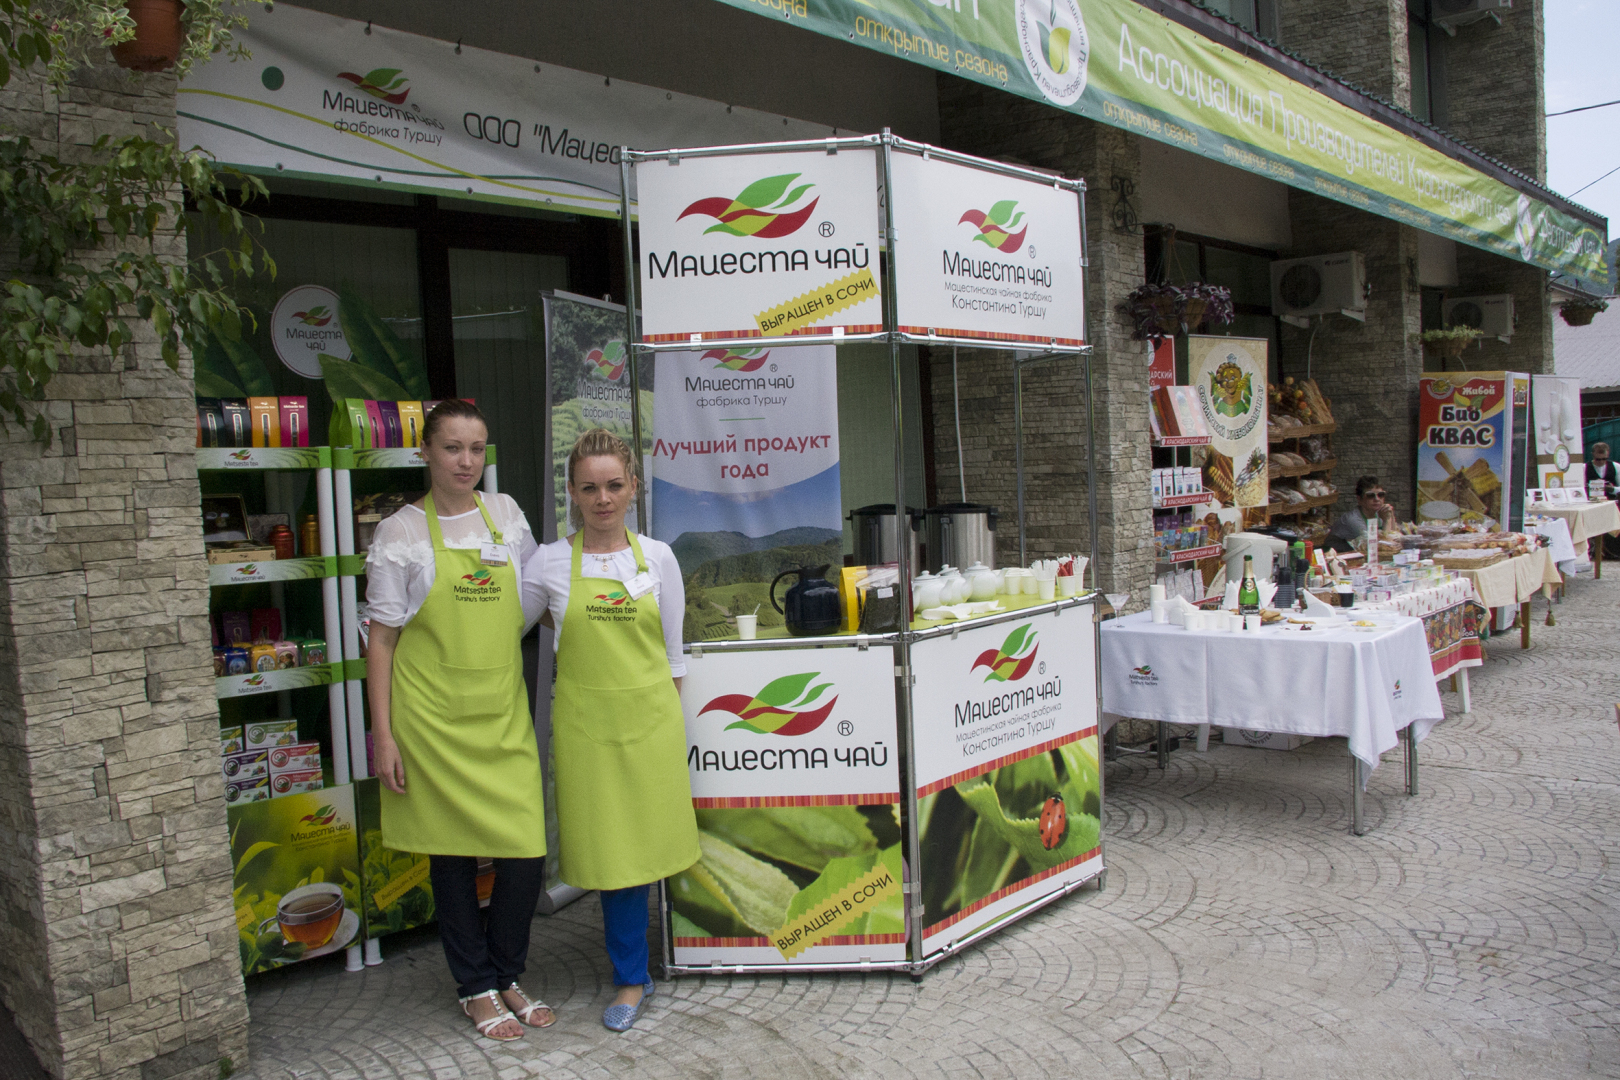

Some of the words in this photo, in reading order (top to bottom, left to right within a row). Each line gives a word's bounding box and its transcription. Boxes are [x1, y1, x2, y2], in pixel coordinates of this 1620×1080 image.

[855, 16, 949, 63] открытие
[955, 49, 1008, 81] сезона
[1119, 23, 1263, 128] Ассоциация
[1269, 90, 1404, 185] Производителей
[333, 118, 400, 137] фабрика
[403, 127, 442, 146] Туршу
[463, 112, 521, 148] ООО
[1103, 101, 1161, 134] открытие
[1164, 122, 1198, 146] сезона
[649, 250, 809, 279] Мацеста
[815, 243, 869, 269] чай
[943, 250, 1025, 284] Мацеста
[1027, 266, 1052, 288] чай
[761, 297, 823, 332] ВЫРАЩЕН
[825, 294, 835, 305] В
[836, 278, 875, 301] СОЧИ
[945, 282, 998, 296] Мацестинская
[1022, 290, 1053, 303] фабрика
[952, 295, 1017, 314] Константина
[1019, 301, 1047, 320] Туршу
[286, 327, 343, 340] Мацеста
[305, 341, 326, 351] чай
[685, 376, 766, 391] Мацеста
[768, 375, 795, 389] чай
[1462, 385, 1496, 395] Живой
[696, 395, 750, 408] фабрика
[753, 395, 787, 407] Туршу
[1441, 405, 1481, 422] Био
[652, 434, 737, 460] Лучший
[744, 435, 831, 456] продукт
[1166, 436, 1197, 445] КРАСНОДАРСКИЙ
[1429, 427, 1492, 445] КВАС
[720, 463, 769, 479] года
[1168, 495, 1200, 505] КРАСНОДАРСКИЙ
[1176, 549, 1208, 559] КРАСНОДАРСКИЙ
[453, 585, 488, 594] Matsesta
[489, 586, 502, 594] tea
[586, 605, 623, 613] Matsesta
[624, 606, 637, 614] tea
[954, 687, 1034, 728] Мацеста
[1036, 675, 1061, 700] чай
[955, 716, 1006, 743] Мацестинская
[1007, 711, 1030, 726] чайная
[1031, 702, 1062, 720] фабрика
[962, 726, 1024, 757] Константина
[1027, 717, 1056, 737] Туршу
[834, 741, 888, 768] чай
[777, 905, 842, 951] ВЫРАЩЕН
[844, 899, 853, 911] В
[852, 873, 893, 904] СОЧИ
